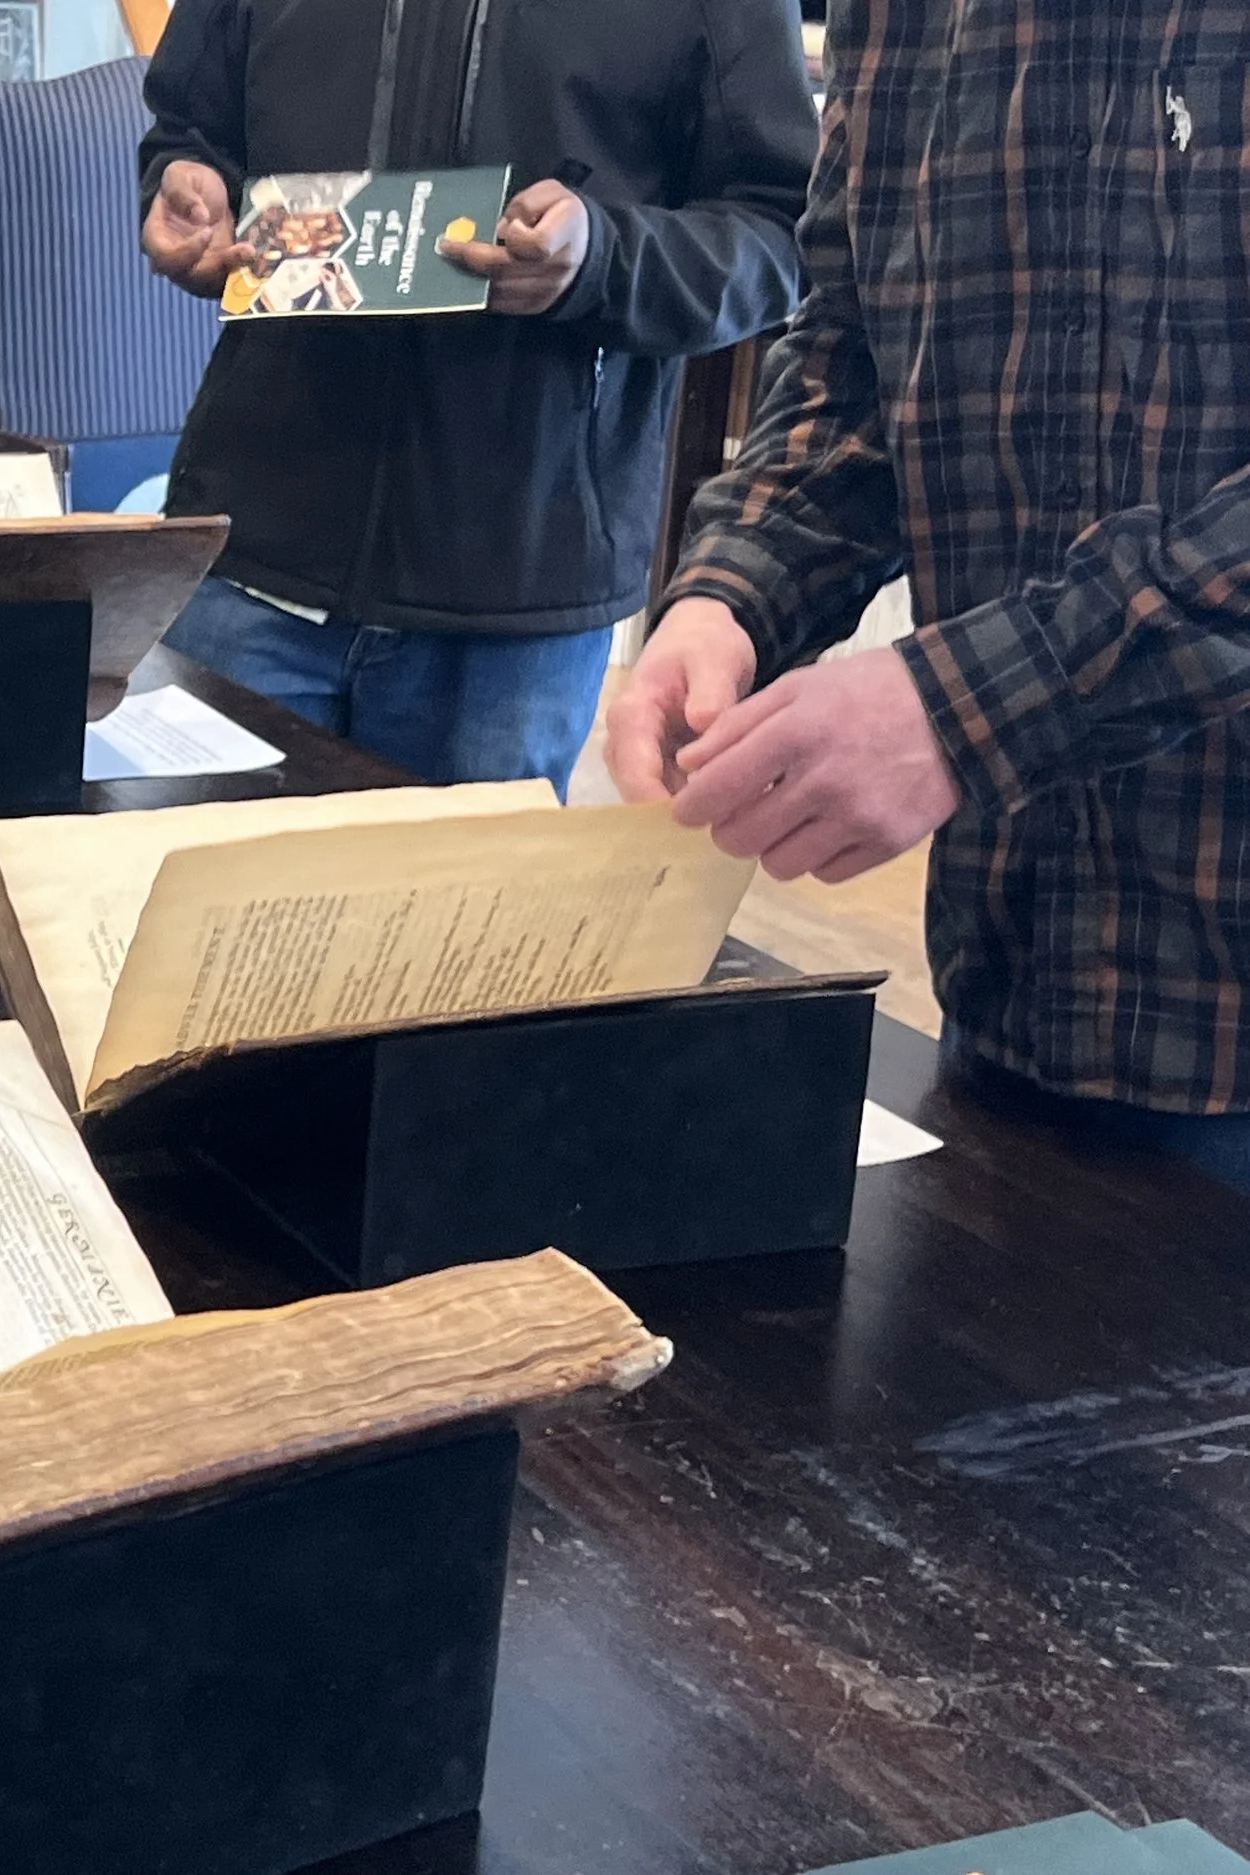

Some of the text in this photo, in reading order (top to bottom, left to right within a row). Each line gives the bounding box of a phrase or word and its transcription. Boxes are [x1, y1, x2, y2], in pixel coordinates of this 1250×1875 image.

[354, 211, 382, 266] Earth
[378, 209, 403, 266] of the
